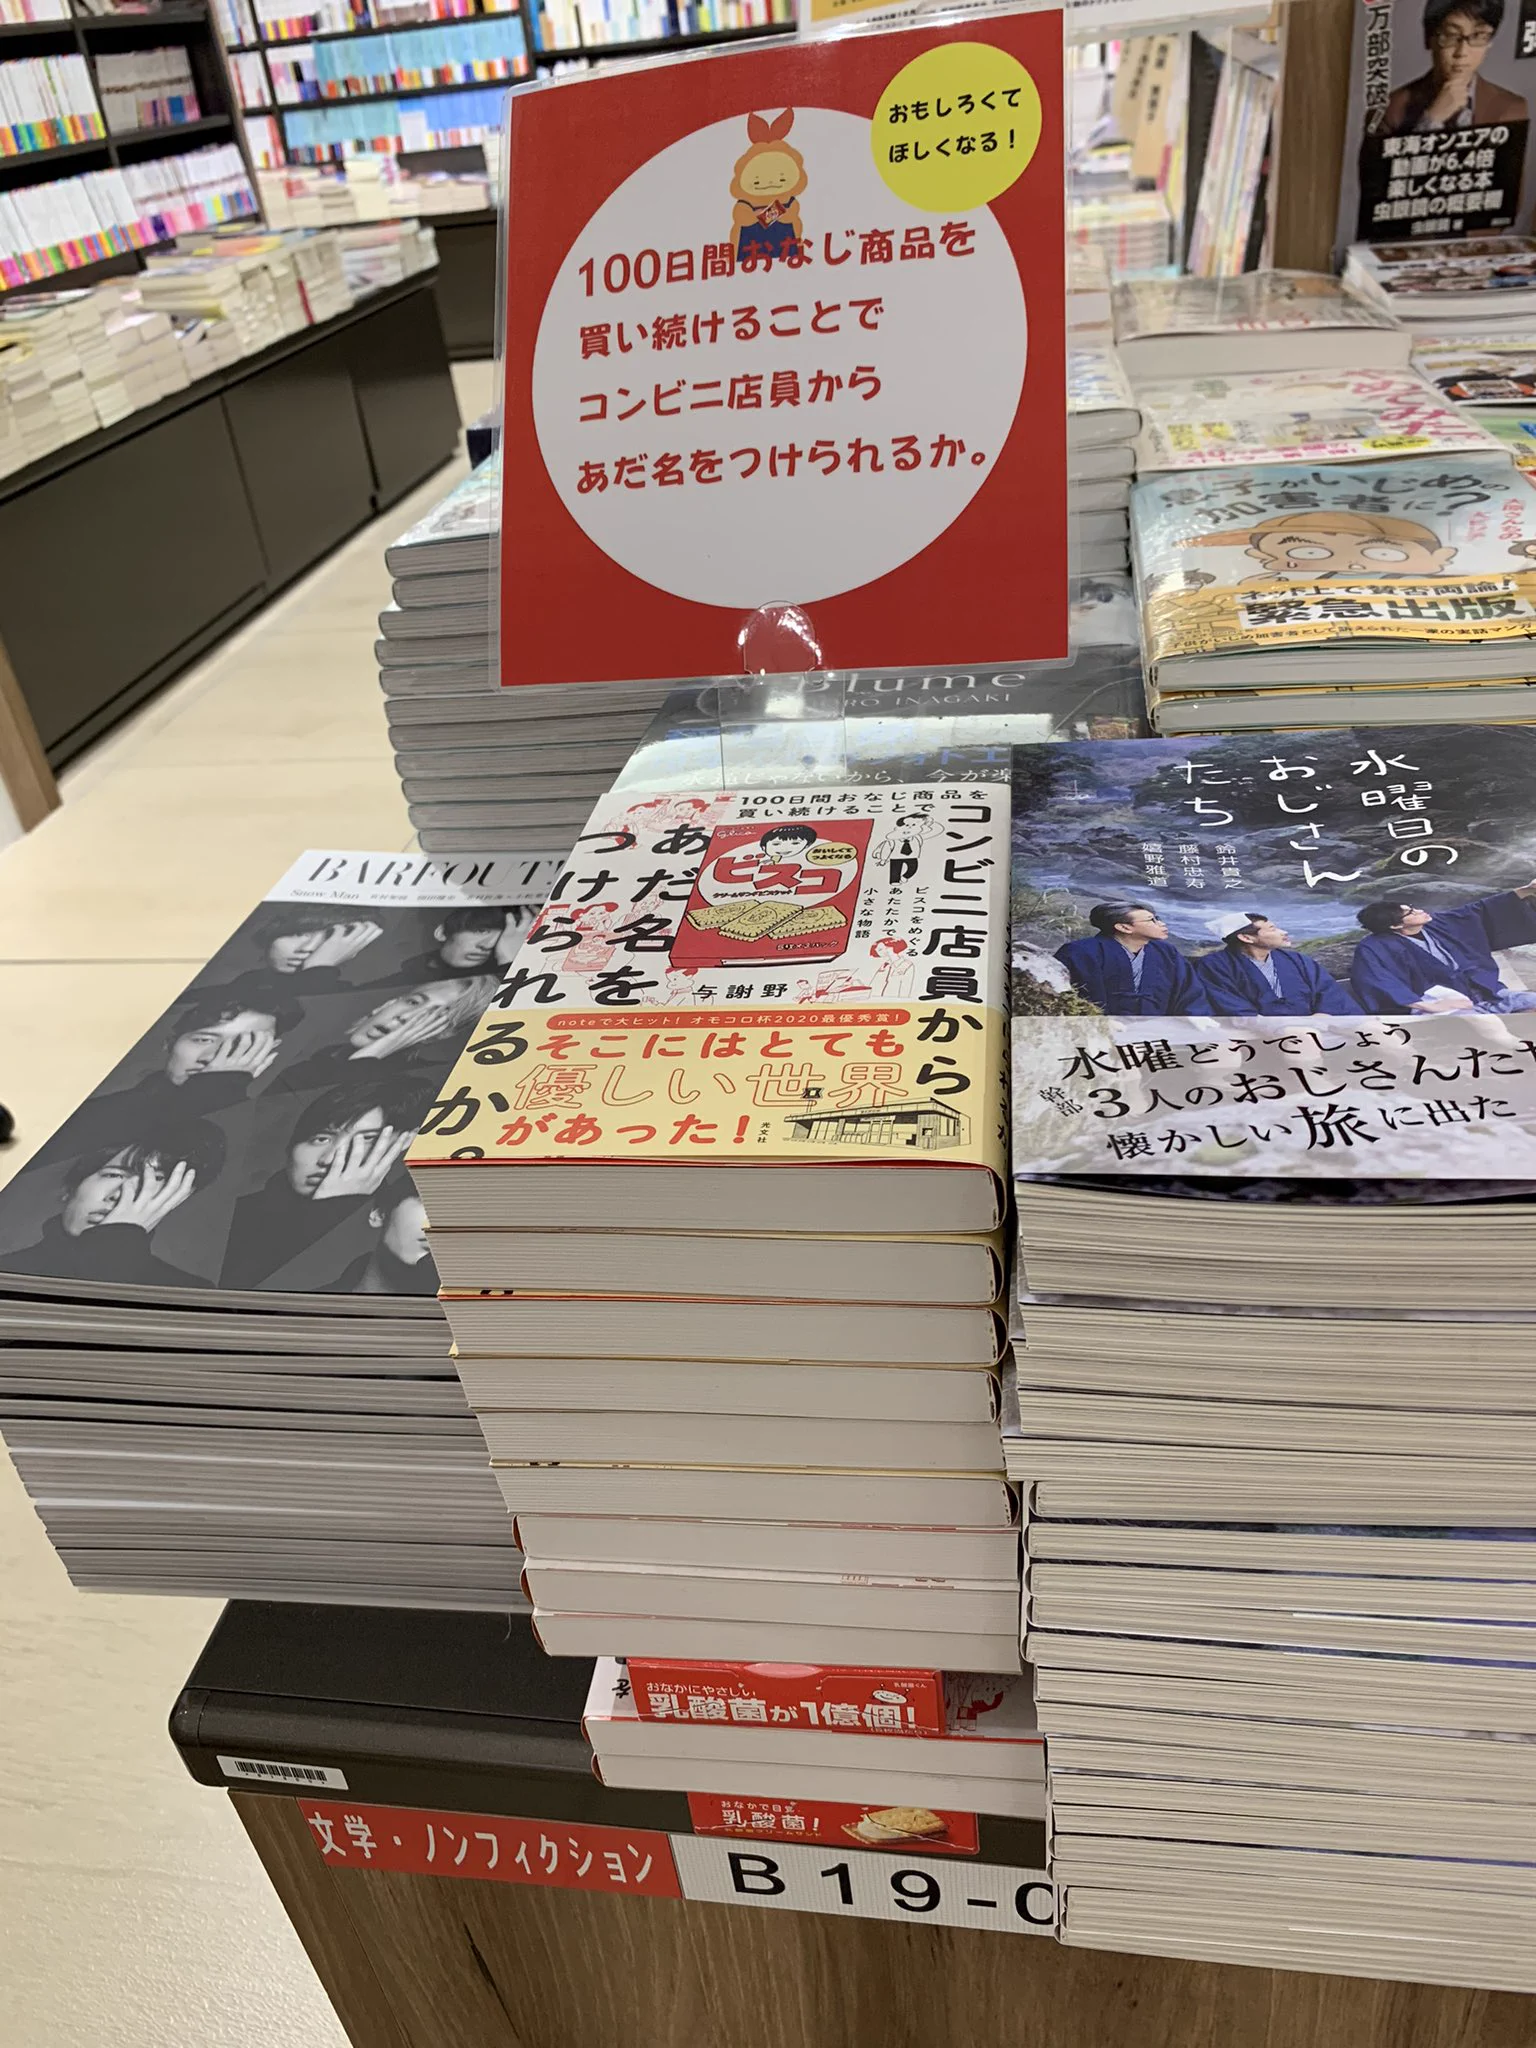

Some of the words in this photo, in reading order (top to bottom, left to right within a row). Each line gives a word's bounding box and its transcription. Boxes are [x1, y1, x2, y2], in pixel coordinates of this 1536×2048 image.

[888, 88, 1022, 124] おもしろくて
[888, 129, 1017, 164] ほしくなる!
[1382, 126, 1509, 158] 東海オンエアの
[1387, 171, 1494, 199] 楽しくなる本
[578, 222, 976, 297] 100日間おなじ商品を
[580, 296, 885, 360] 買い続けることで
[579, 366, 882, 423] コンビニ店員から
[576, 434, 985, 493] あだ名をつけられるか。
[1245, 594, 1526, 626] 緊急出版
[737, 803, 935, 818] 買い続けることで
[741, 789, 988, 806] 100日間おなじ商品を
[1173, 760, 1233, 826] たち
[1350, 749, 1459, 867] 水曜日の
[1259, 755, 1362, 888] おじさん
[713, 853, 842, 895] ビスコ
[1179, 844, 1206, 889] 藤村忠寿
[1214, 843, 1245, 889] 鈴井貴之
[330, 890, 360, 900] Man
[588, 824, 710, 1006] あだ名を
[855, 887, 878, 938] 小さな物語
[882, 887, 903, 937] あたたかで
[906, 887, 930, 957] ビスコをめぐる
[916, 805, 995, 1096] コンビニ店員から
[417, 831, 636, 1160] つけられるか。
[692, 981, 789, 1001] 与謝野
[557, 1016, 680, 1028] noteで大ヒット!
[690, 1013, 900, 1026] オモコロ杯2020最優秀賞!
[536, 1029, 903, 1060] そこにはとても
[1058, 1022, 1412, 1081] 水曜どうでしょう
[514, 1062, 909, 1111] 優しい世界
[496, 1113, 751, 1146] があった!
[757, 1122, 772, 1144] 光文社
[1106, 1094, 1517, 1162] 懐かしい旅に出た
[646, 1682, 755, 1697] おなかにやさしい
[648, 1693, 916, 1729] 乳酸菌が1億個!
[721, 1810, 819, 1831] 乳酸菌!
[308, 1813, 653, 1884] 文学・ノンフィクション
